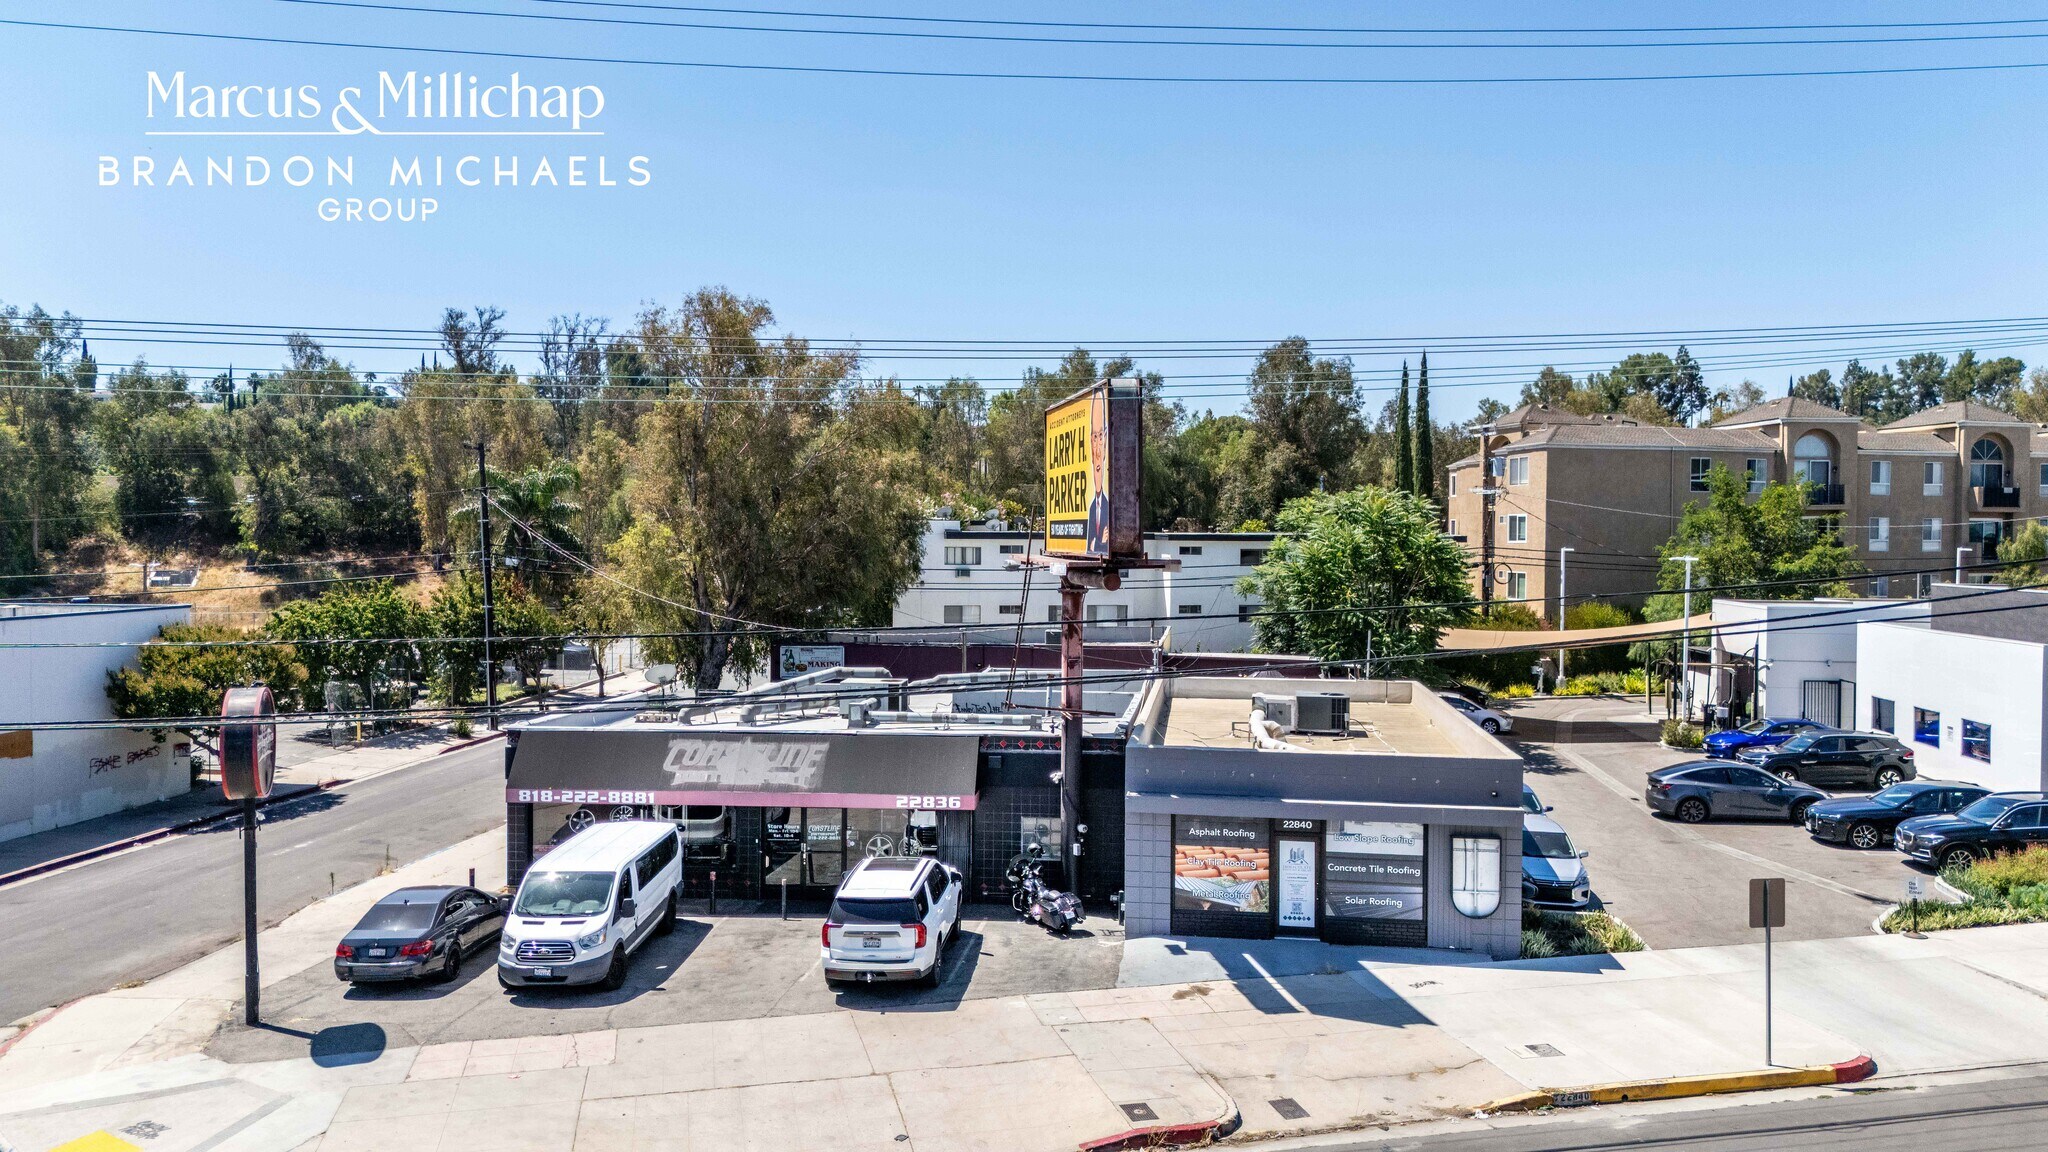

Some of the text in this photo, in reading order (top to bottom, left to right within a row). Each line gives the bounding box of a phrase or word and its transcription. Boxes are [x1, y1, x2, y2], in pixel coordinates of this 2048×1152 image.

[1049, 425, 1087, 470] LARRY H.
[1049, 470, 1087, 514] PARKER
[807, 660, 841, 668] MAKING
[662, 738, 830, 772] COALINE
[518, 790, 655, 804] 818-222-8881
[896, 796, 961, 808] 22836
[1283, 820, 1312, 829] 22840
[1189, 828, 1255, 839] Asphalt Roofing
[1334, 833, 1415, 846] Low Slope Roofing
[1187, 857, 1257, 869] Clay Tile Roofing
[1327, 863, 1421, 877] Concrete Tile Roofing
[1192, 889, 1251, 900] Metal Roofing
[1345, 896, 1403, 908] Solar Roofing
